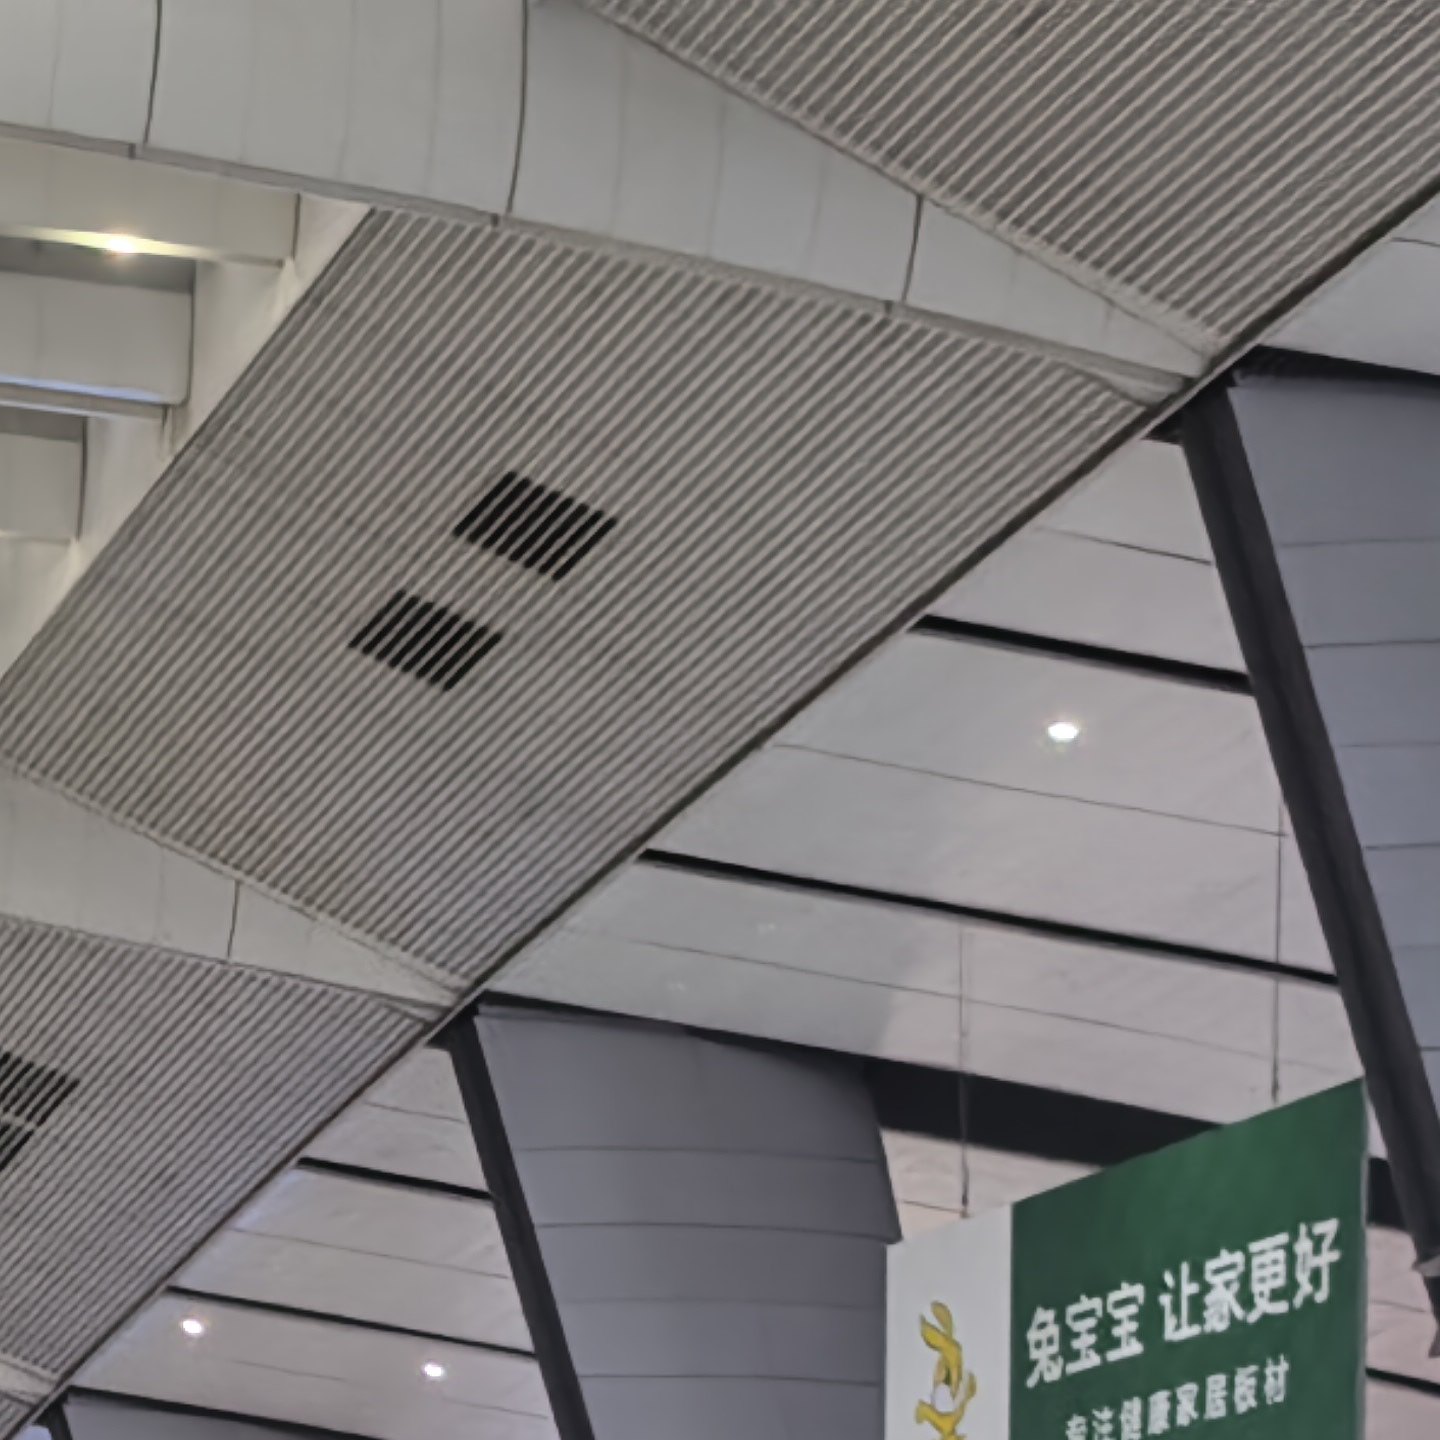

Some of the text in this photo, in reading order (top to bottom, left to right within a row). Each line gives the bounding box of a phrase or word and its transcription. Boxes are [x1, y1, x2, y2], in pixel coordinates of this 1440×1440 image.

[1025, 1218, 1342, 1388] 兔宝宝 让家更好
